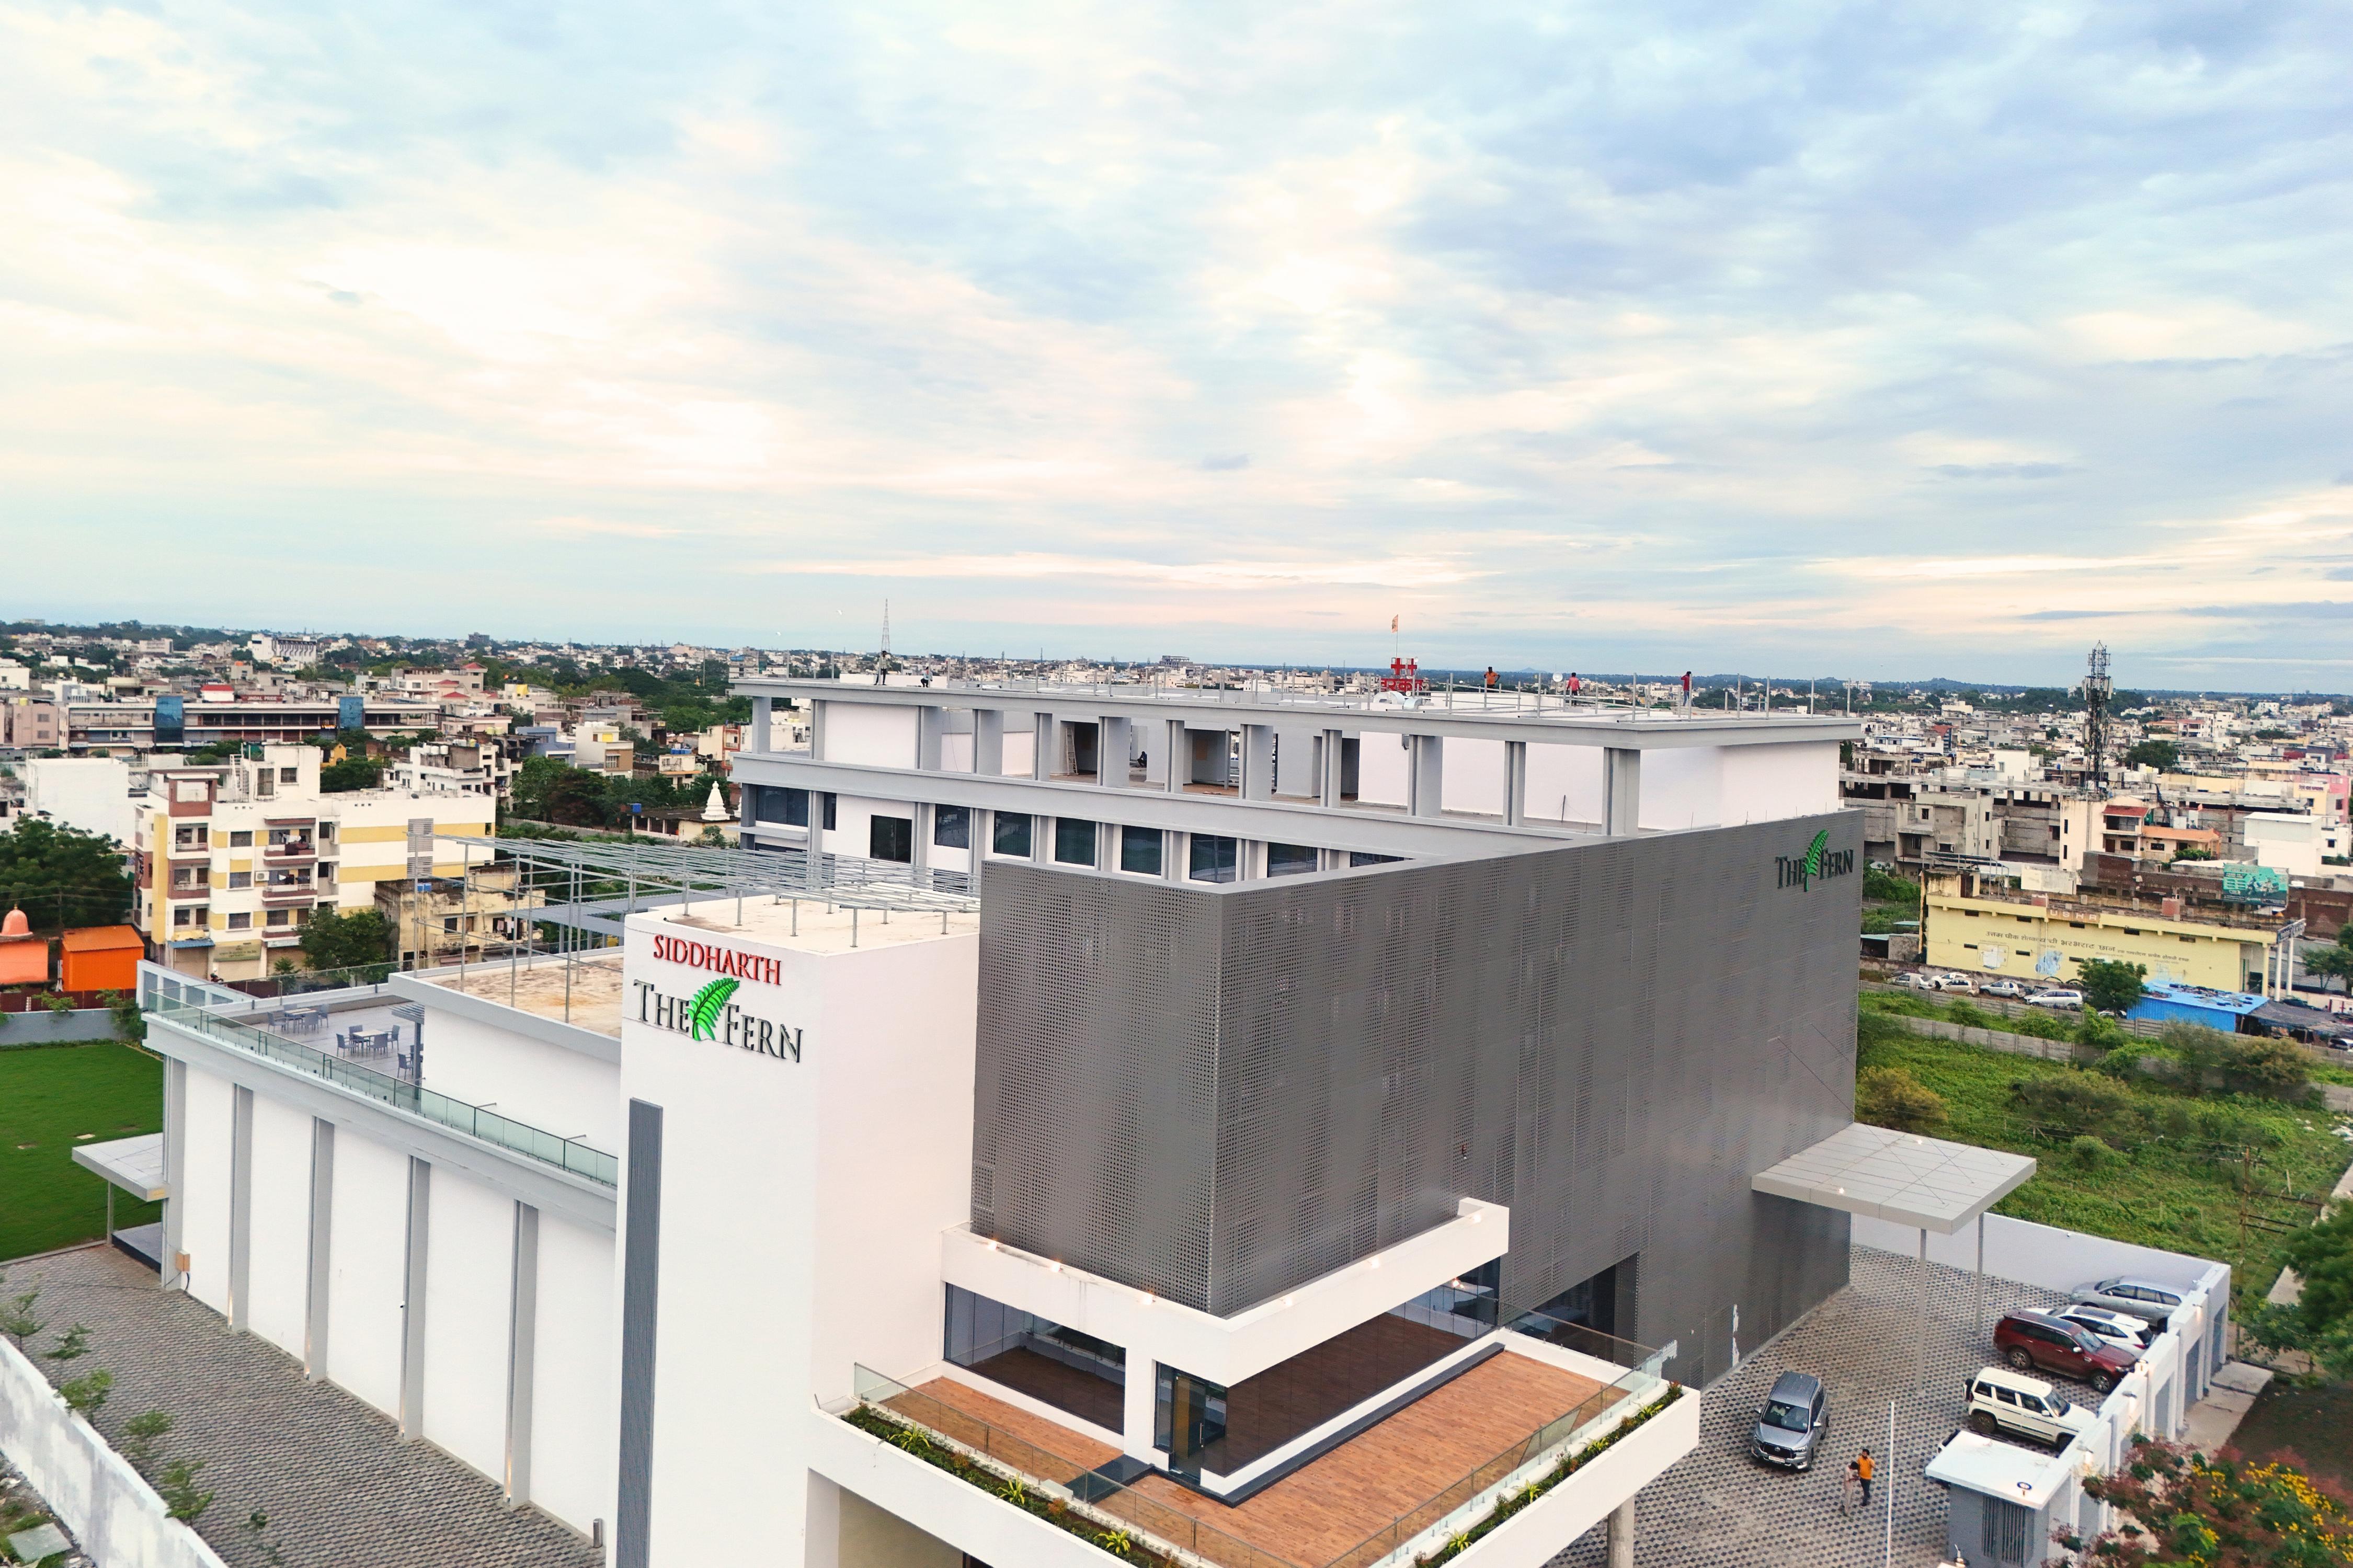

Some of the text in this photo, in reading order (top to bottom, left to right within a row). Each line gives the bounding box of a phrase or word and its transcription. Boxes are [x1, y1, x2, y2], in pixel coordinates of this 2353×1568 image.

[1775, 848, 1854, 888] THE FERN
[653, 934, 782, 985] SIDDHARTH
[633, 979, 804, 1063] THE FERN
